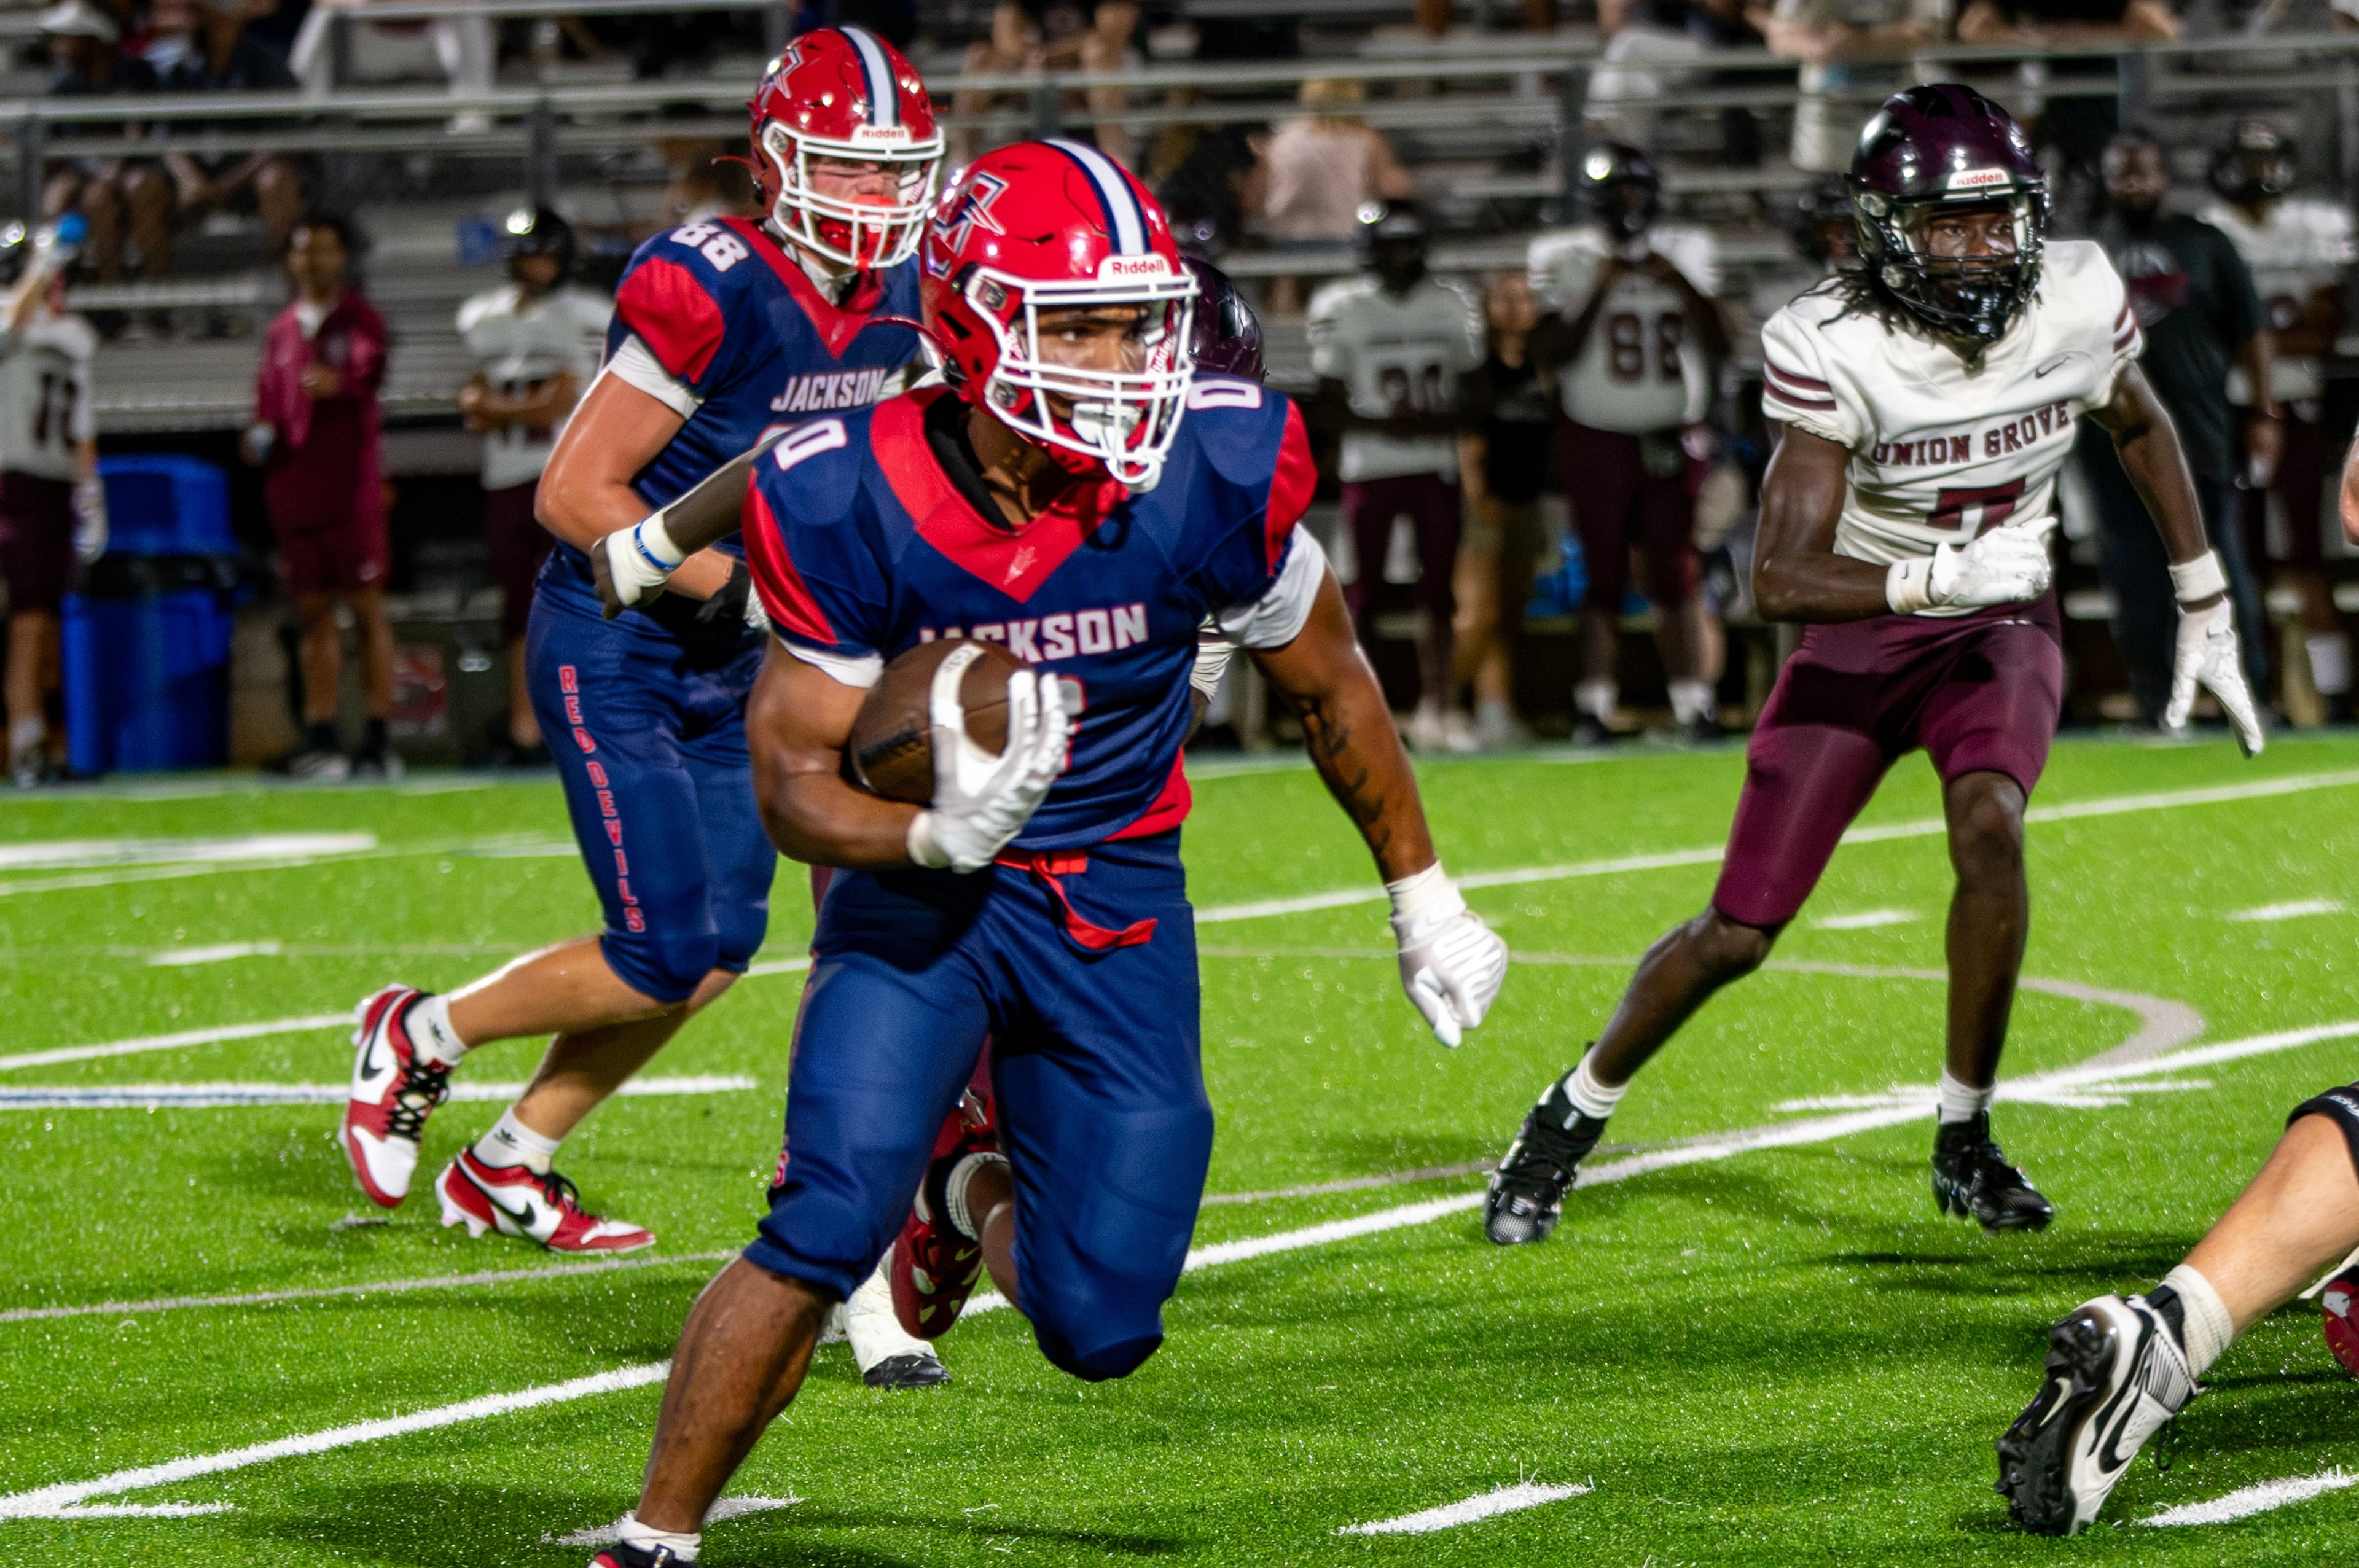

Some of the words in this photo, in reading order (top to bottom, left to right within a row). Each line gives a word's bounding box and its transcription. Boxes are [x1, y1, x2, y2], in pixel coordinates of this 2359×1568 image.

[669, 223, 749, 273] 88
[1112, 259, 1165, 275] Riddell
[770, 368, 887, 412] JACKSON
[1872, 434, 1971, 466] UNION
[1984, 400, 2071, 458] GROVE
[1925, 475, 2027, 539] 7
[920, 601, 1149, 664] KSON
[558, 665, 596, 754] RED
[585, 760, 646, 934] DEVILS
